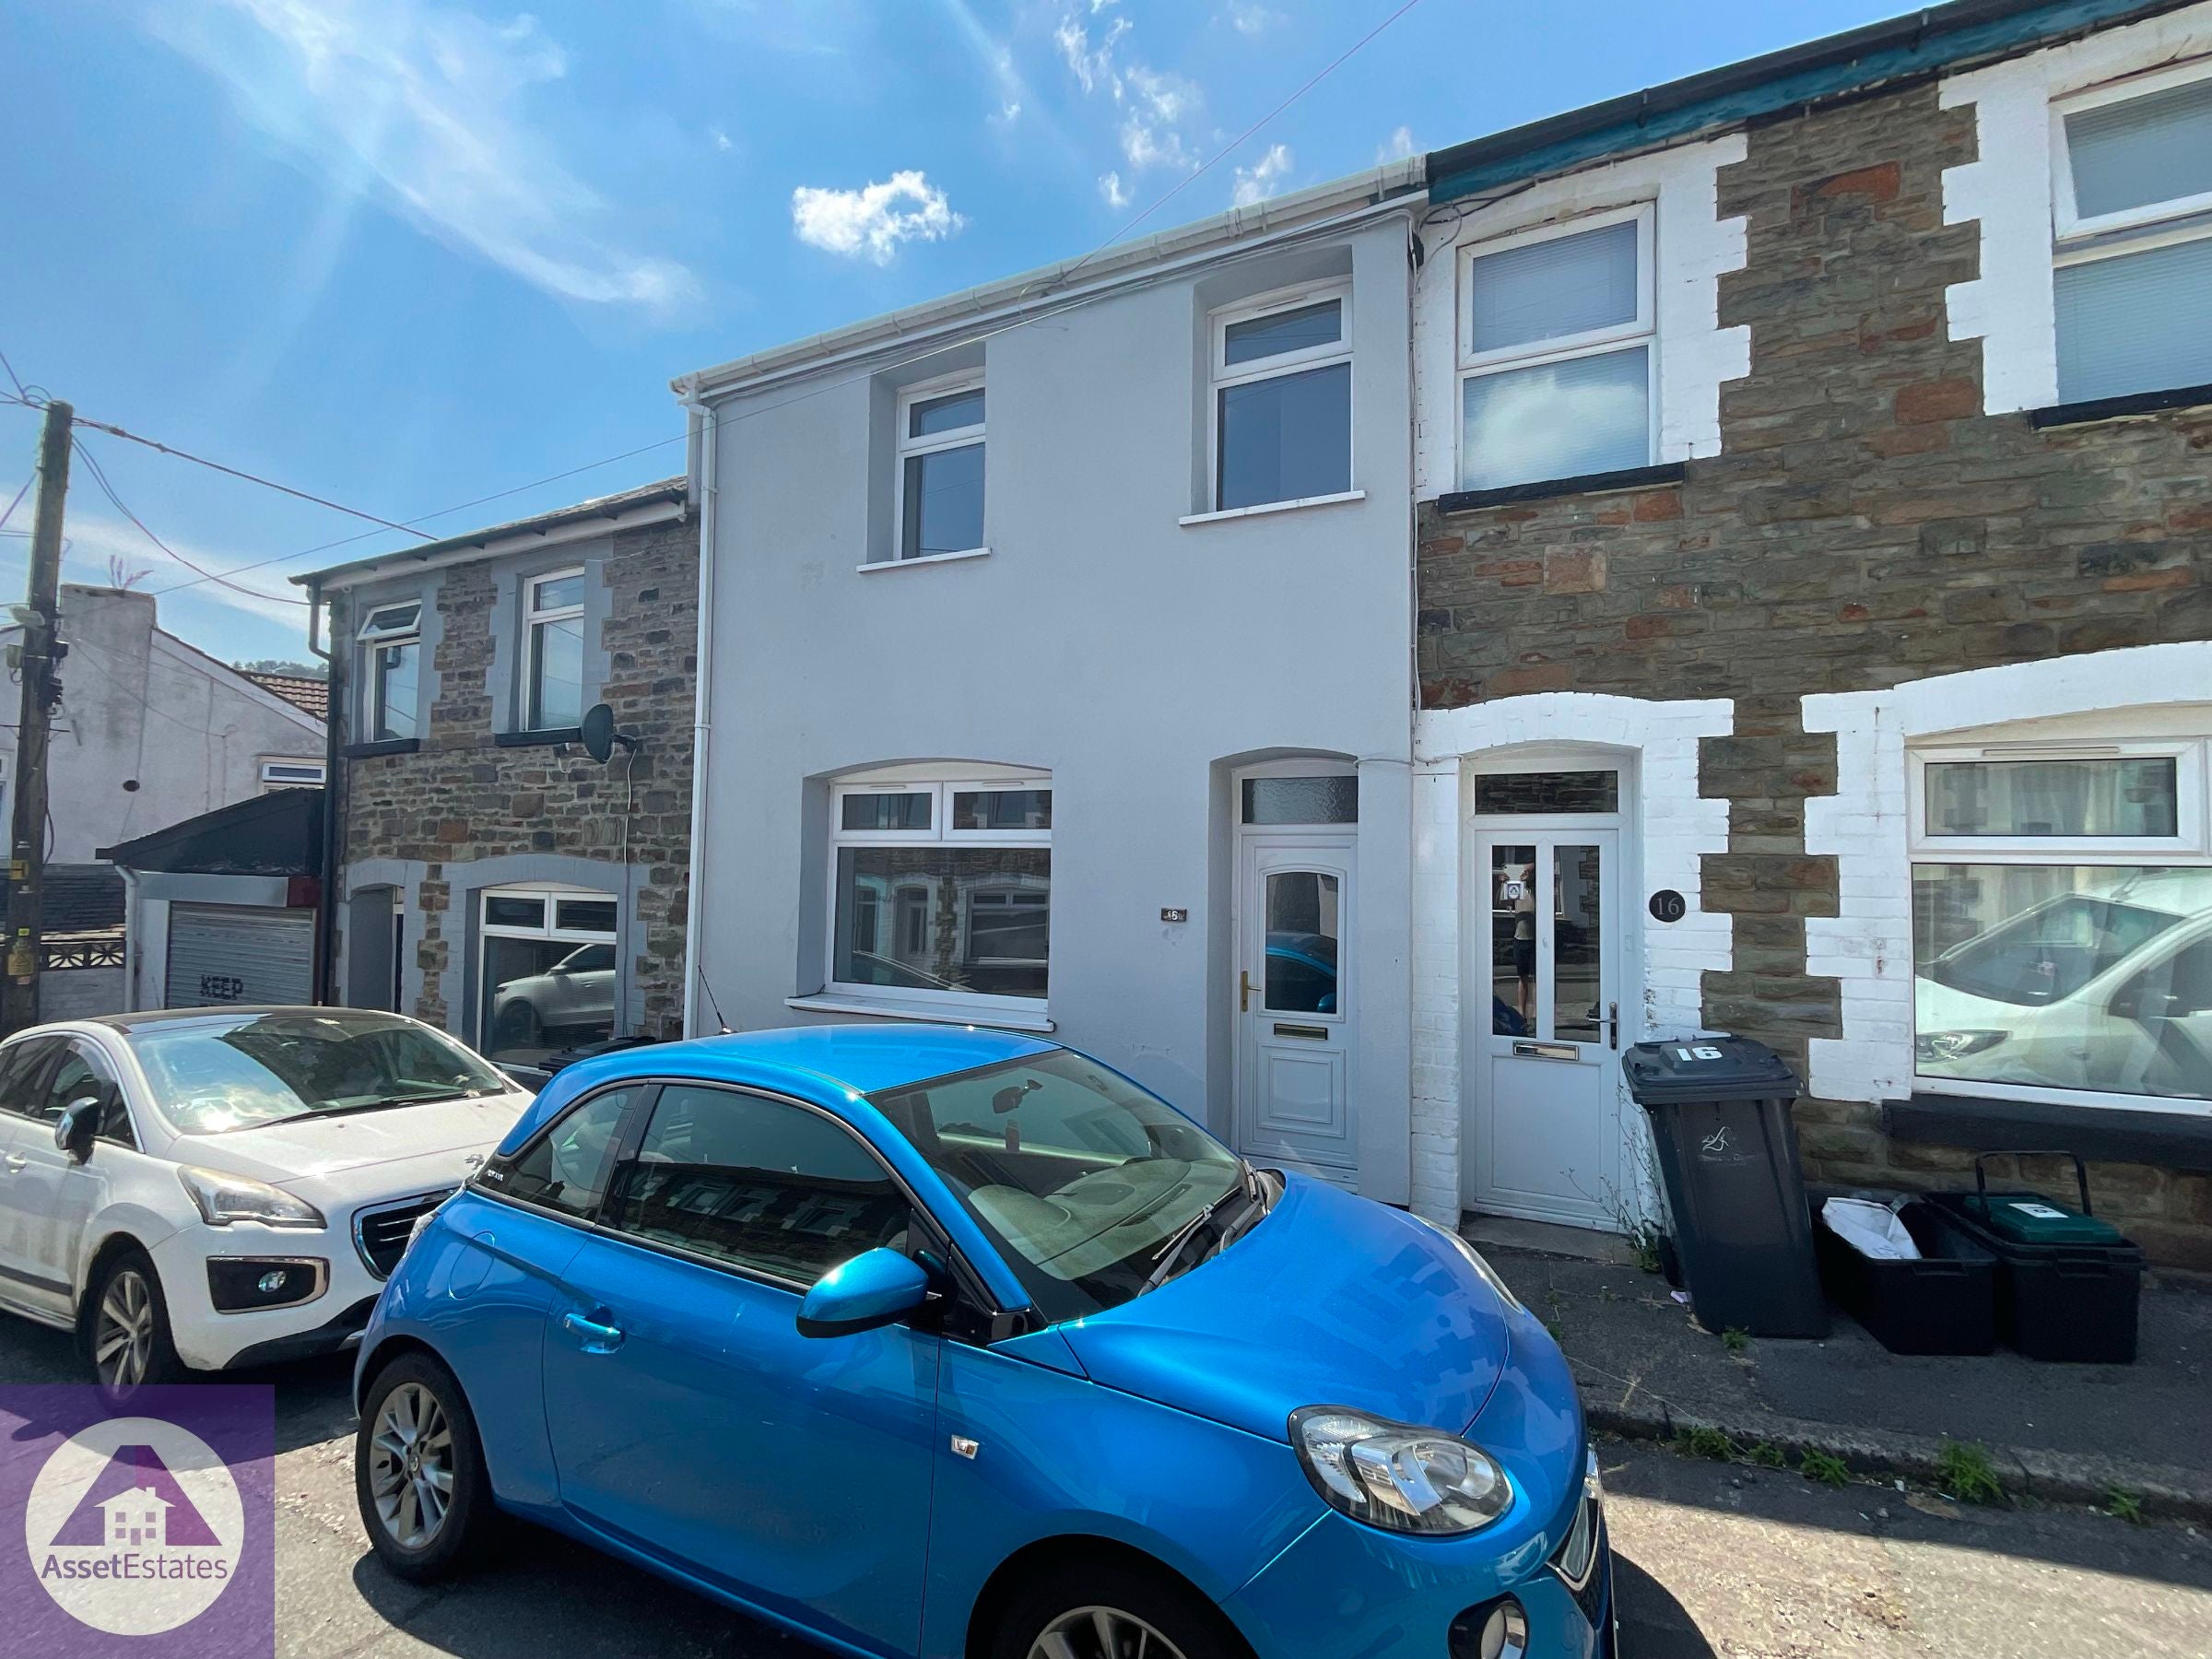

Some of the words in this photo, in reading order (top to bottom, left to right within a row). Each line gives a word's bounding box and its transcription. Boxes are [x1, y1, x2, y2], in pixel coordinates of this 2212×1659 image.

[1656, 897, 1680, 915] 16
[200, 973, 243, 1000] KEEP
[1677, 1046, 1724, 1062] 16
